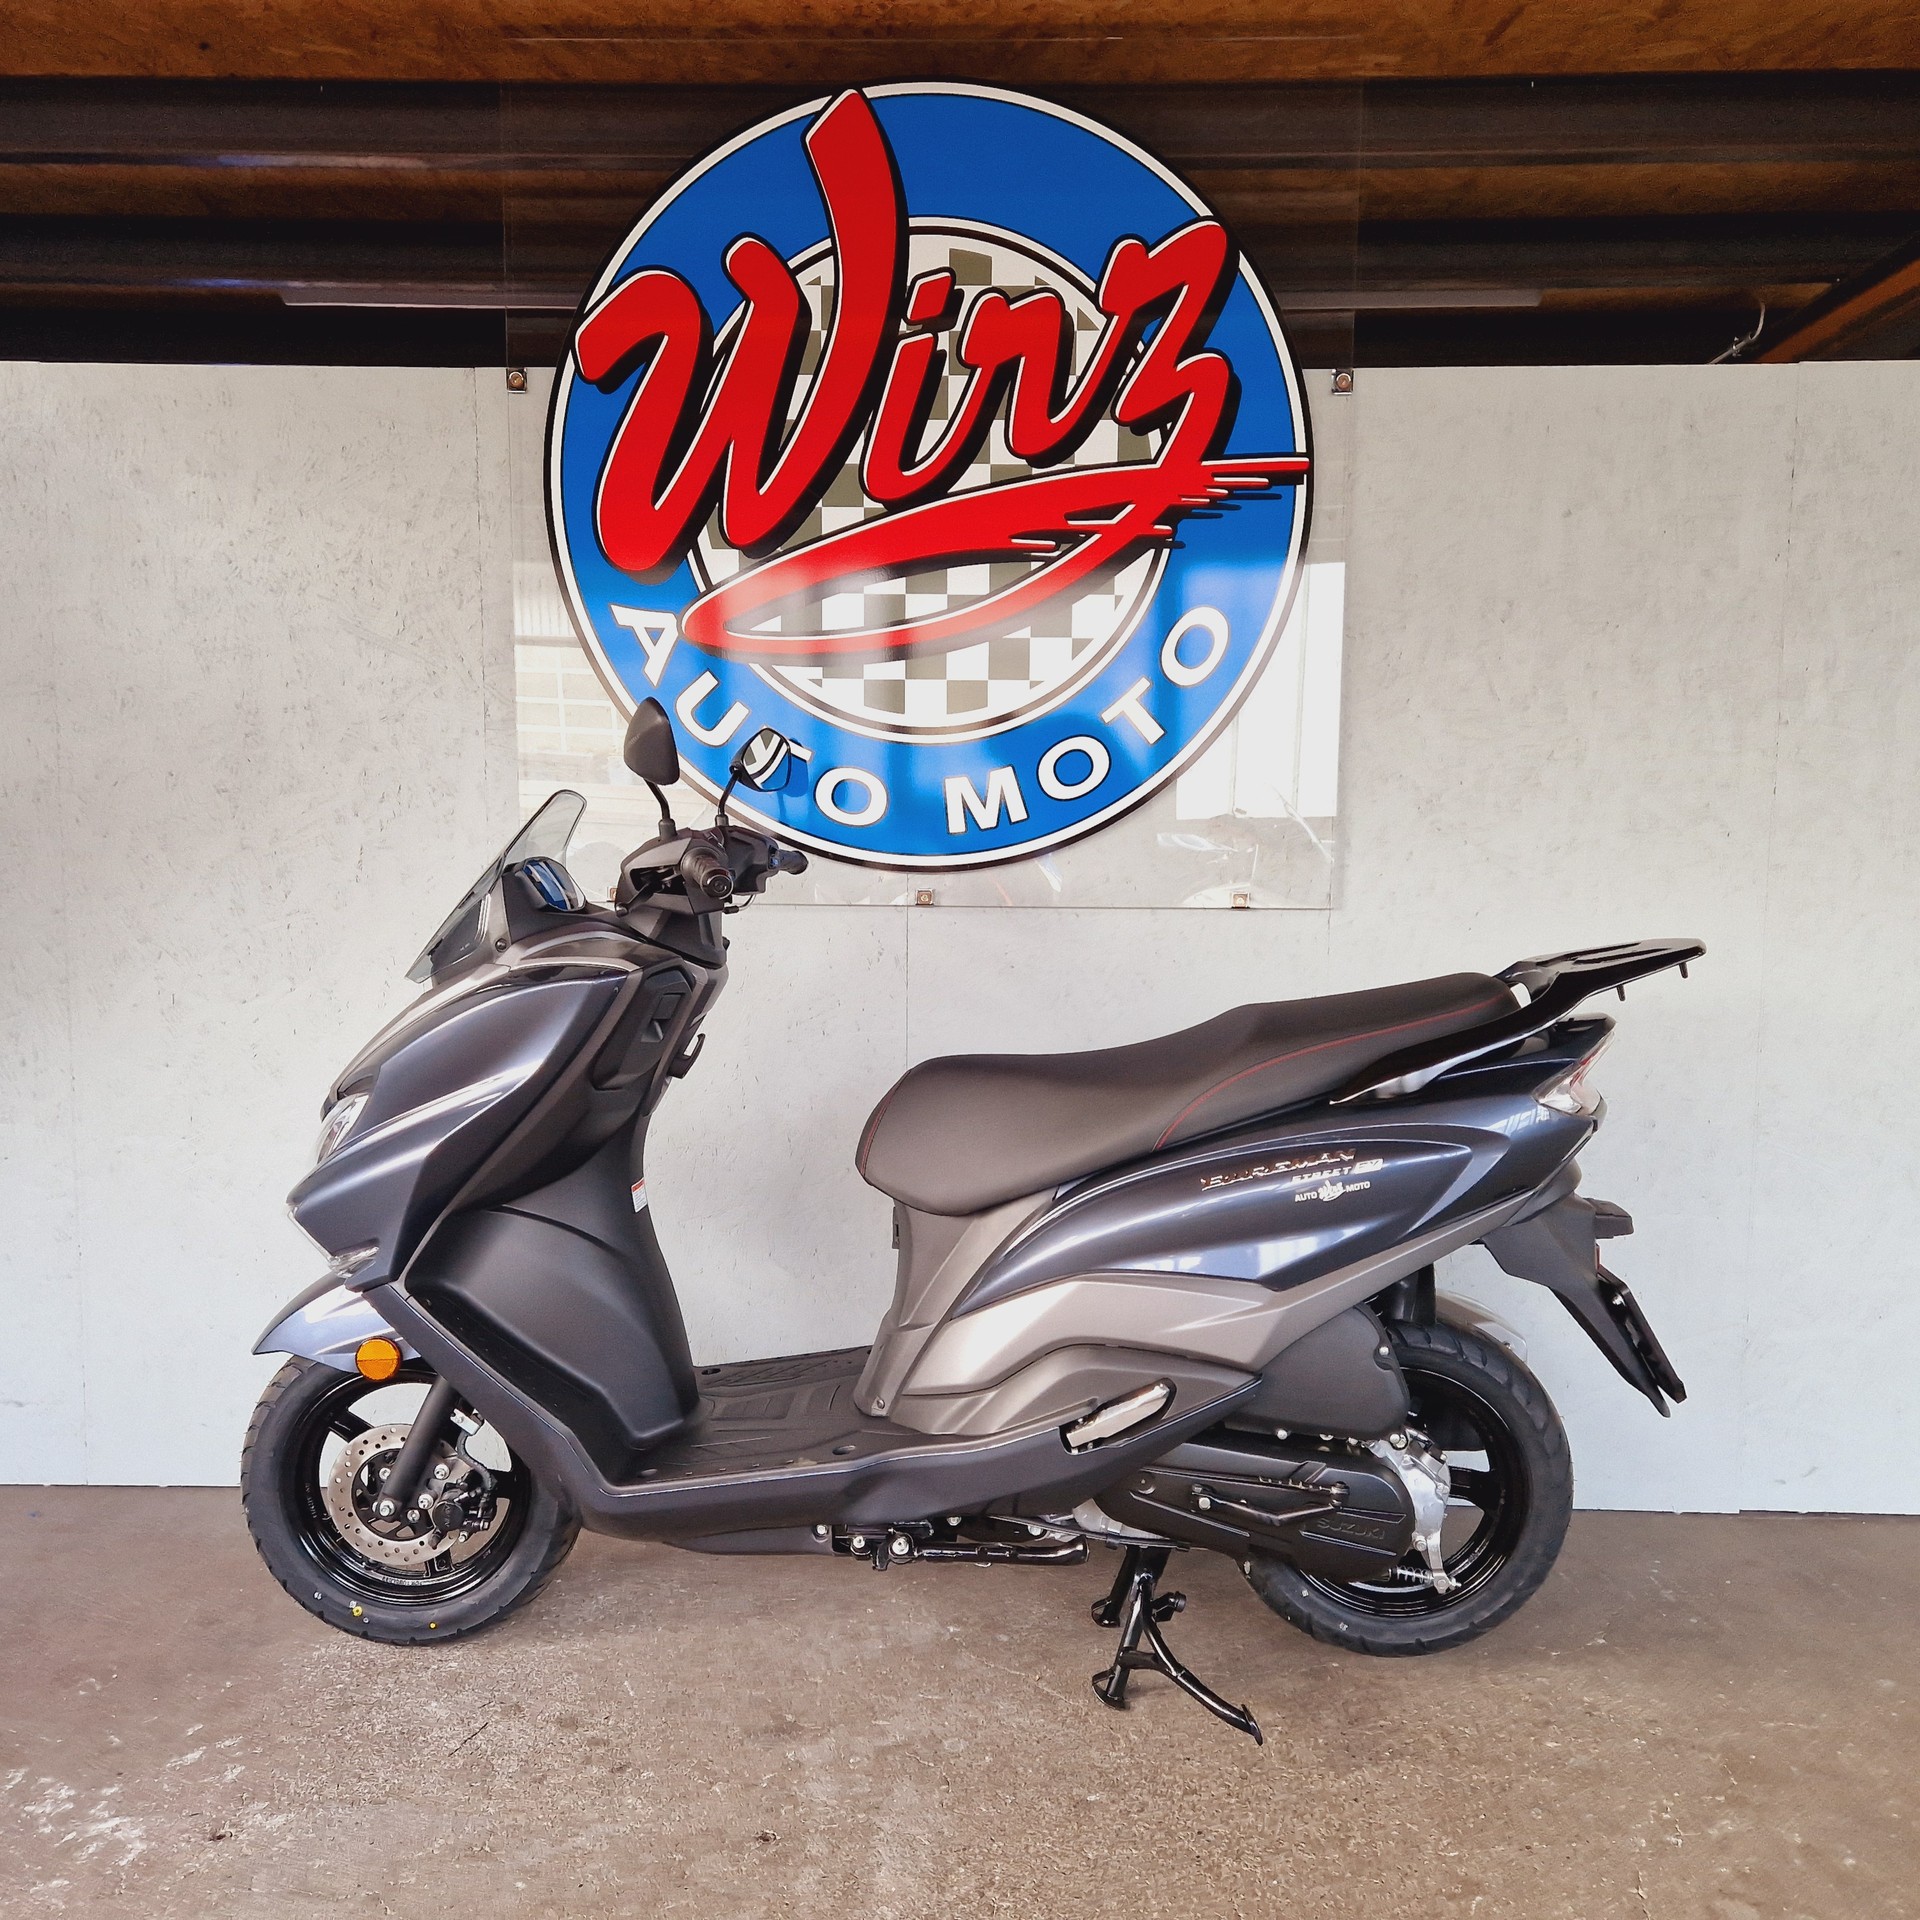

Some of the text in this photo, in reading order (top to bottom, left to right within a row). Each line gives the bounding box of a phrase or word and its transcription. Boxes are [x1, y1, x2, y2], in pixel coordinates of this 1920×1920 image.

[609, 603, 1230, 835] AUO MOTO
[1295, 1191, 1318, 1203] AUTO
[1345, 1181, 1371, 1193] MOTO
[1316, 1517, 1386, 1540] SUZUKI
